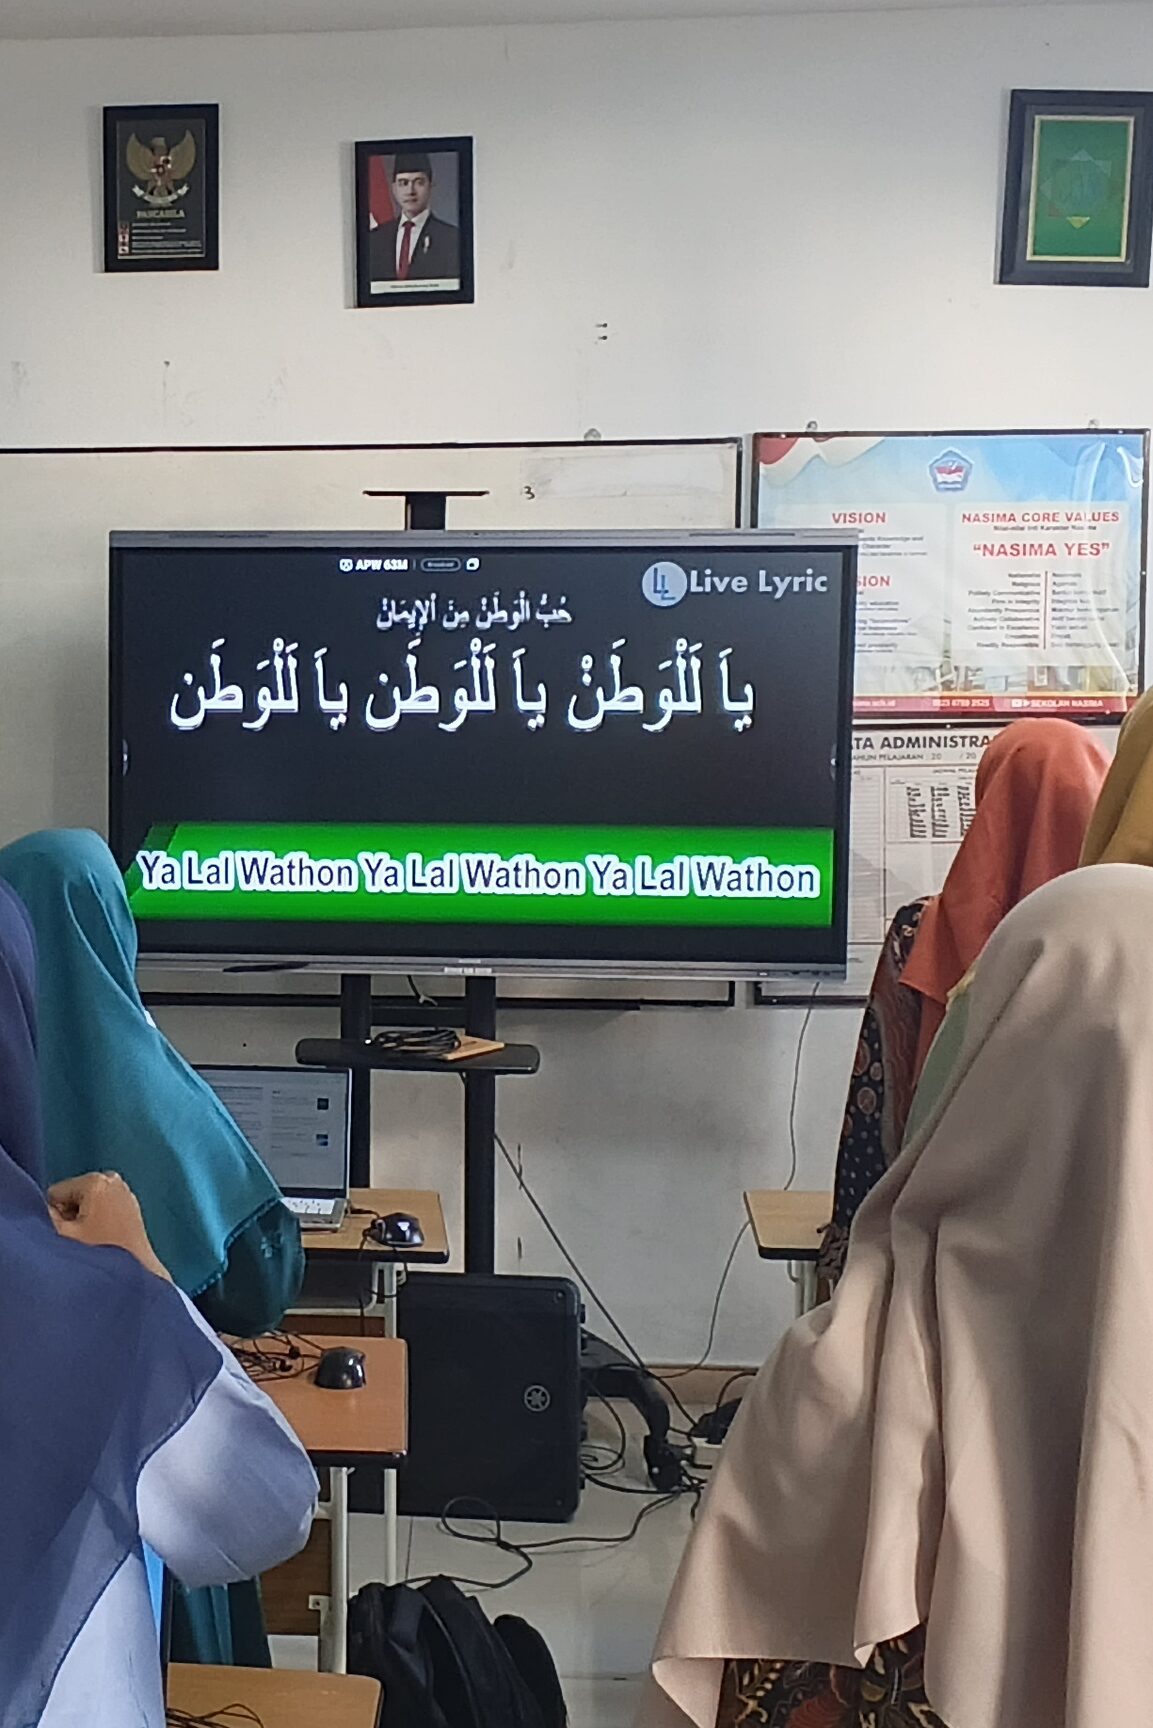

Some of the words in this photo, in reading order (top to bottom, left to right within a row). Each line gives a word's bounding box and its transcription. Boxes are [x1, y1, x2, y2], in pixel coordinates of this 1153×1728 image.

[832, 511, 886, 524] VISION
[961, 512, 1017, 523] NASIMA
[1022, 512, 1060, 523] CORE
[1065, 511, 1120, 523] VALUES
[690, 568, 748, 593] Live
[758, 568, 828, 600] Lyric
[856, 575, 891, 587] SION
[851, 736, 875, 750] TA
[880, 735, 991, 749] ADMINISTRA
[141, 855, 176, 885] Ya
[187, 856, 229, 885] Lal
[240, 855, 353, 886] Wathon
[364, 857, 399, 887] Ya
[411, 857, 454, 888] Lal
[465, 858, 581, 889] Wathon
[592, 860, 628, 890] Ya
[641, 860, 684, 891] Lal
[696, 861, 815, 892] Wathon
